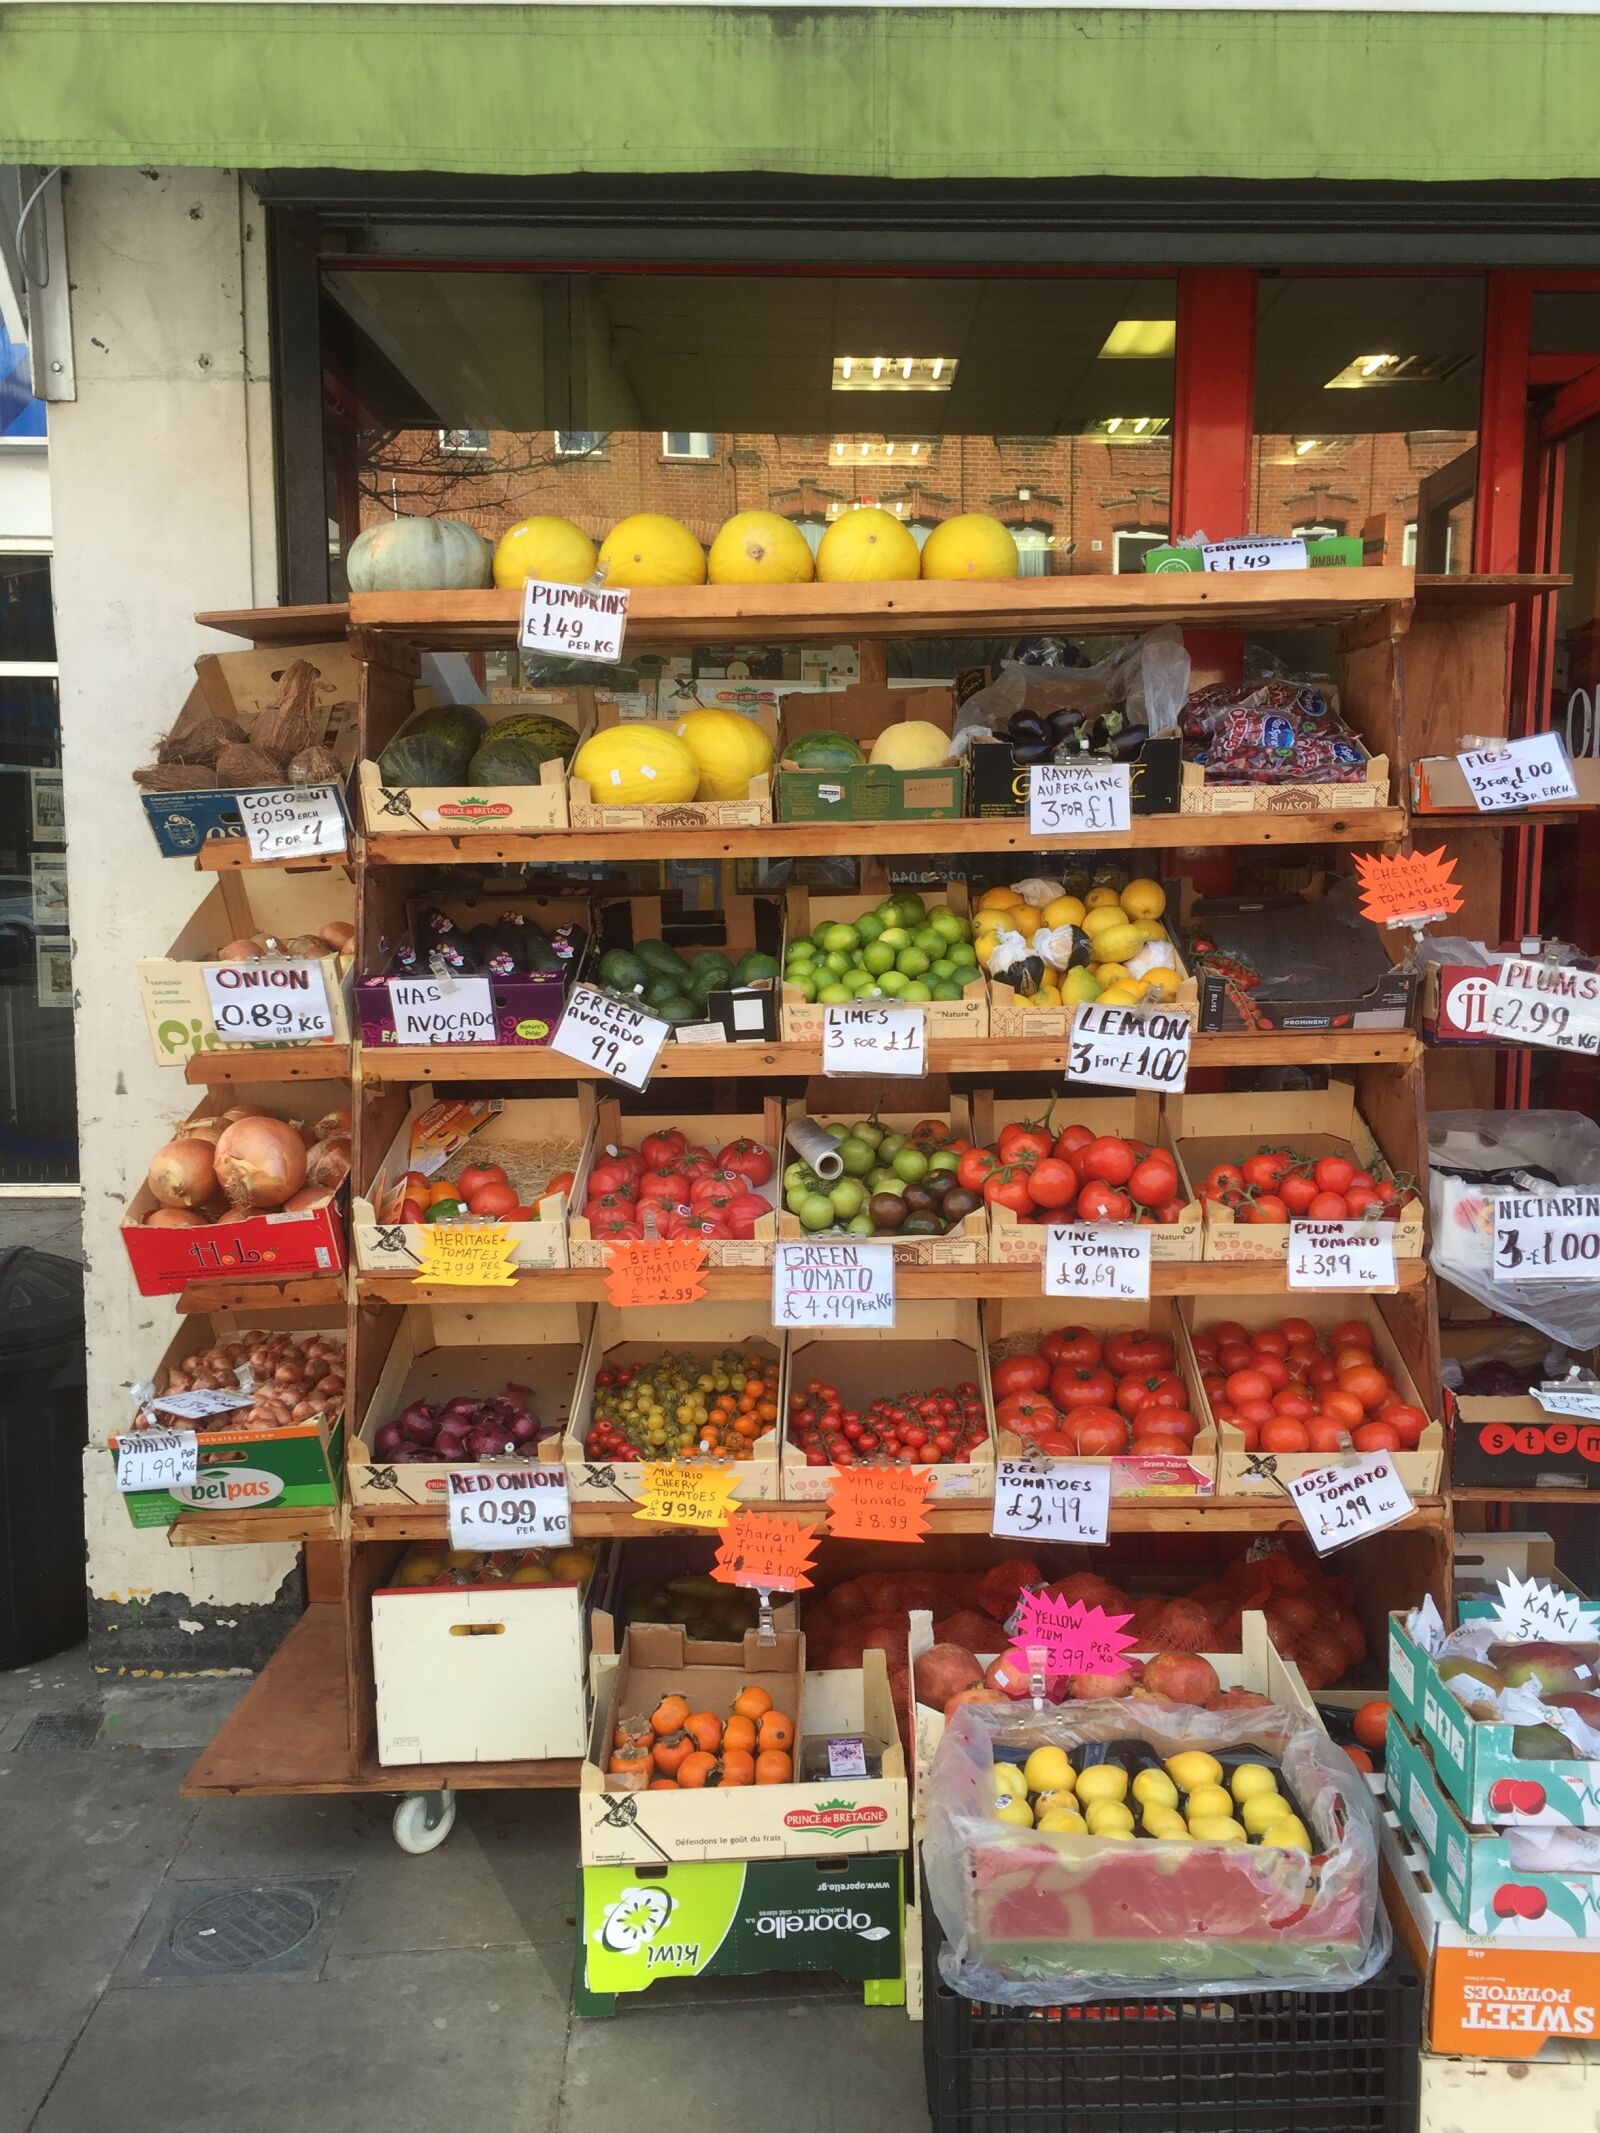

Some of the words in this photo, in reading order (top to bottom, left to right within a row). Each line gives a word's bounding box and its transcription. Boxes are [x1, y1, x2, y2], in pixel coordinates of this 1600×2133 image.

[532, 585, 628, 615] PUMPKINS
[527, 612, 583, 639] £1.49
[568, 640, 591, 650] PER
[593, 639, 614, 653] KG
[1465, 749, 1512, 768] FIGS
[1041, 766, 1093, 781] RAVIYA
[1472, 776, 1487, 792] 3
[1487, 777, 1510, 787] FOR
[243, 789, 330, 809] COCOUT
[297, 811, 319, 820] EACH
[440, 807, 464, 816] PRINCE
[473, 806, 512, 815] BRETAGNE
[1041, 800, 1060, 827] 3
[1061, 801, 1084, 816] FOR
[1085, 795, 1117, 829] £1
[257, 828, 271, 852] 2
[275, 834, 302, 847] FOR
[302, 820, 323, 846] £1
[1372, 863, 1428, 880] CHERRY
[1377, 883, 1447, 904] TOMATOES
[215, 968, 311, 990] ONION
[1505, 962, 1599, 1000] PLUMS
[396, 986, 442, 1006] HAS
[573, 990, 644, 1028] GREEN
[829, 1008, 889, 1026] LIMES
[941, 1010, 970, 1018] Nature
[1491, 998, 1570, 1037] £2.99
[299, 1015, 326, 1032] KG
[407, 1011, 495, 1034] AVOCADO
[567, 1006, 644, 1046] AVOCADO
[1079, 1006, 1190, 1041] LEMON
[1283, 1018, 1328, 1026] PROMINENT
[828, 1029, 845, 1049] 3
[854, 1038, 878, 1049] FOR
[883, 1027, 920, 1051] £1
[1557, 1035, 1574, 1047] PER
[1577, 1033, 1598, 1049] KG
[1068, 1042, 1095, 1074] 3
[1499, 1197, 1600, 1220] NECTARIN
[1053, 1229, 1099, 1242] VINE
[1157, 1233, 1186, 1241] Nature
[1294, 1223, 1345, 1235] PLUM
[1070, 1244, 1140, 1259] TOMATO
[1308, 1236, 1381, 1249] TOMATO
[439, 1246, 499, 1260] TOMATES
[630, 1246, 675, 1265] BEEF
[783, 1246, 859, 1267] GREEN
[427, 1259, 475, 1278] £7.99
[480, 1261, 502, 1270] PER
[621, 1257, 696, 1278] TOMATOES
[1359, 1270, 1378, 1279] KG
[635, 1275, 672, 1287] PINK
[784, 1267, 873, 1292] TOMATO
[1120, 1283, 1136, 1294] KG
[783, 1293, 855, 1320] £4.99
[857, 1299, 877, 1311] PER
[876, 1292, 892, 1310] KG
[182, 1461, 196, 1471] KG
[653, 1467, 674, 1477] MIX
[680, 1470, 703, 1480] TRIO
[1143, 1460, 1165, 1469] Green
[191, 1480, 270, 1502] belpas
[450, 1472, 495, 1494] RED
[496, 1471, 566, 1491] ONION
[655, 1477, 699, 1492] CHEERY
[847, 1475, 884, 1490] vine
[890, 1481, 929, 1498] cherry
[998, 1476, 1093, 1492] TOMATOES
[1294, 1470, 1338, 1498] LOSE
[1316, 1465, 1389, 1504] TOMATO
[652, 1488, 717, 1502] TOMATOES
[460, 1499, 537, 1525] £0.99
[1378, 1500, 1397, 1512] KG
[516, 1525, 536, 1535] PER
[543, 1515, 567, 1532] KG
[1079, 1525, 1100, 1535] KG
[737, 1539, 786, 1557] fruit
[1035, 1609, 1083, 1630] YELLOW
[1523, 1592, 1578, 1634] KAKI
[1035, 1626, 1063, 1642] PLUM
[1516, 1618, 1532, 1639] 3
[1091, 1641, 1111, 1653] PER
[786, 1813, 822, 1826] PRINCE
[822, 1813, 833, 1824] de
[833, 1810, 884, 1823] BRETAGNE
[675, 1837, 718, 1847] Défendons
[719, 1836, 729, 1845] le
[730, 1834, 749, 1847] goût
[750, 1835, 761, 1844] du
[762, 1833, 782, 1843] frais
[817, 1881, 890, 1892] www.oporello.gr
[820, 1905, 845, 1915] packing
[756, 1907, 872, 1939] oporello
[648, 1943, 699, 1968] kiwi
[1467, 1950, 1485, 1959] 6kg
[1463, 1984, 1572, 2004] POTATOES
[1461, 2002, 1595, 2034] SWEET
